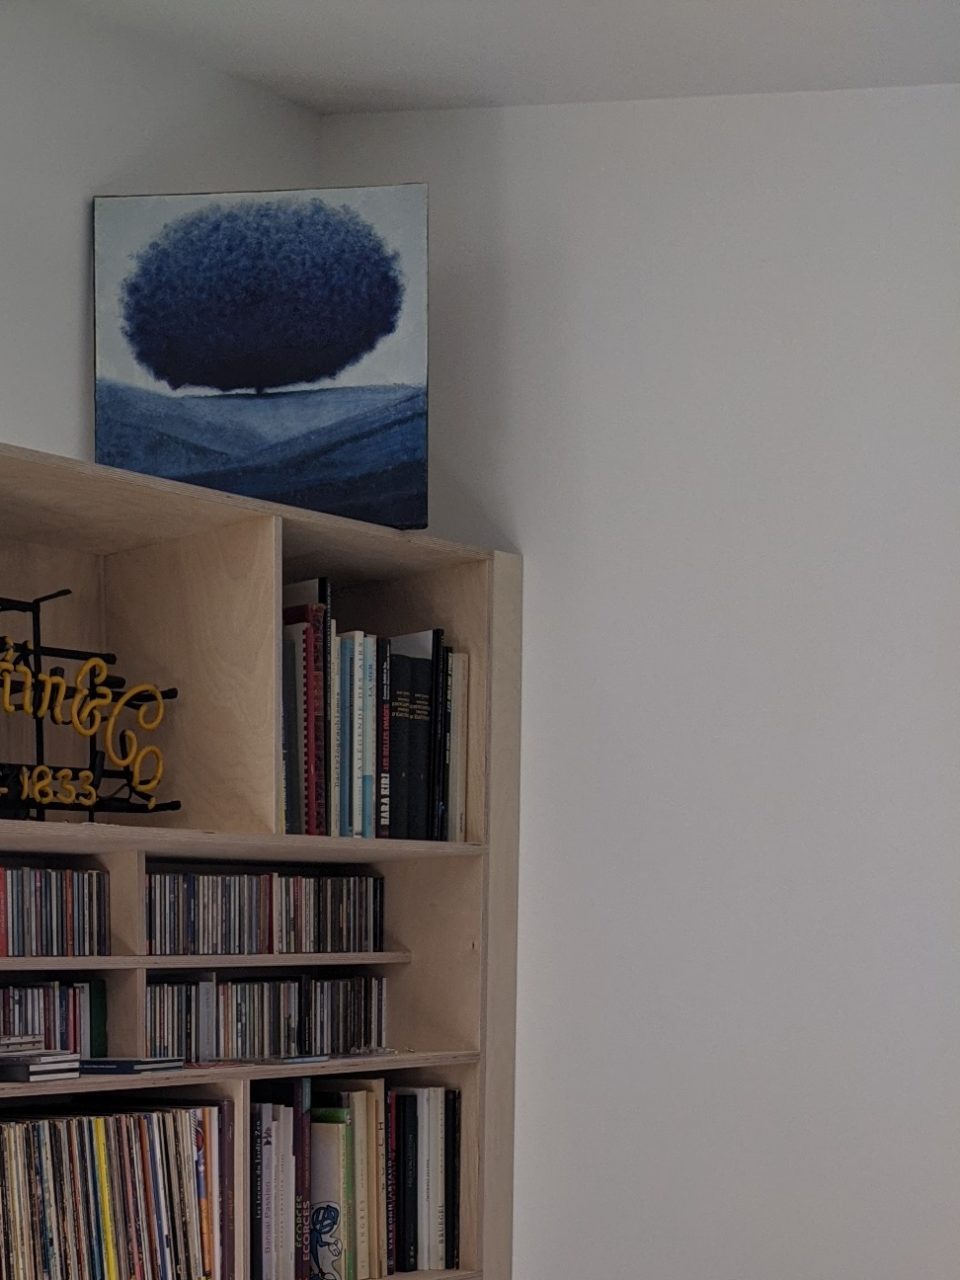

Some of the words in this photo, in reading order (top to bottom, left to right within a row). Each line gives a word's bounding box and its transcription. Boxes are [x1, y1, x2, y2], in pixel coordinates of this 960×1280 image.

[19, 764, 98, 806] 1833
[380, 772, 390, 795] KIRI
[380, 797, 390, 826] HARA
